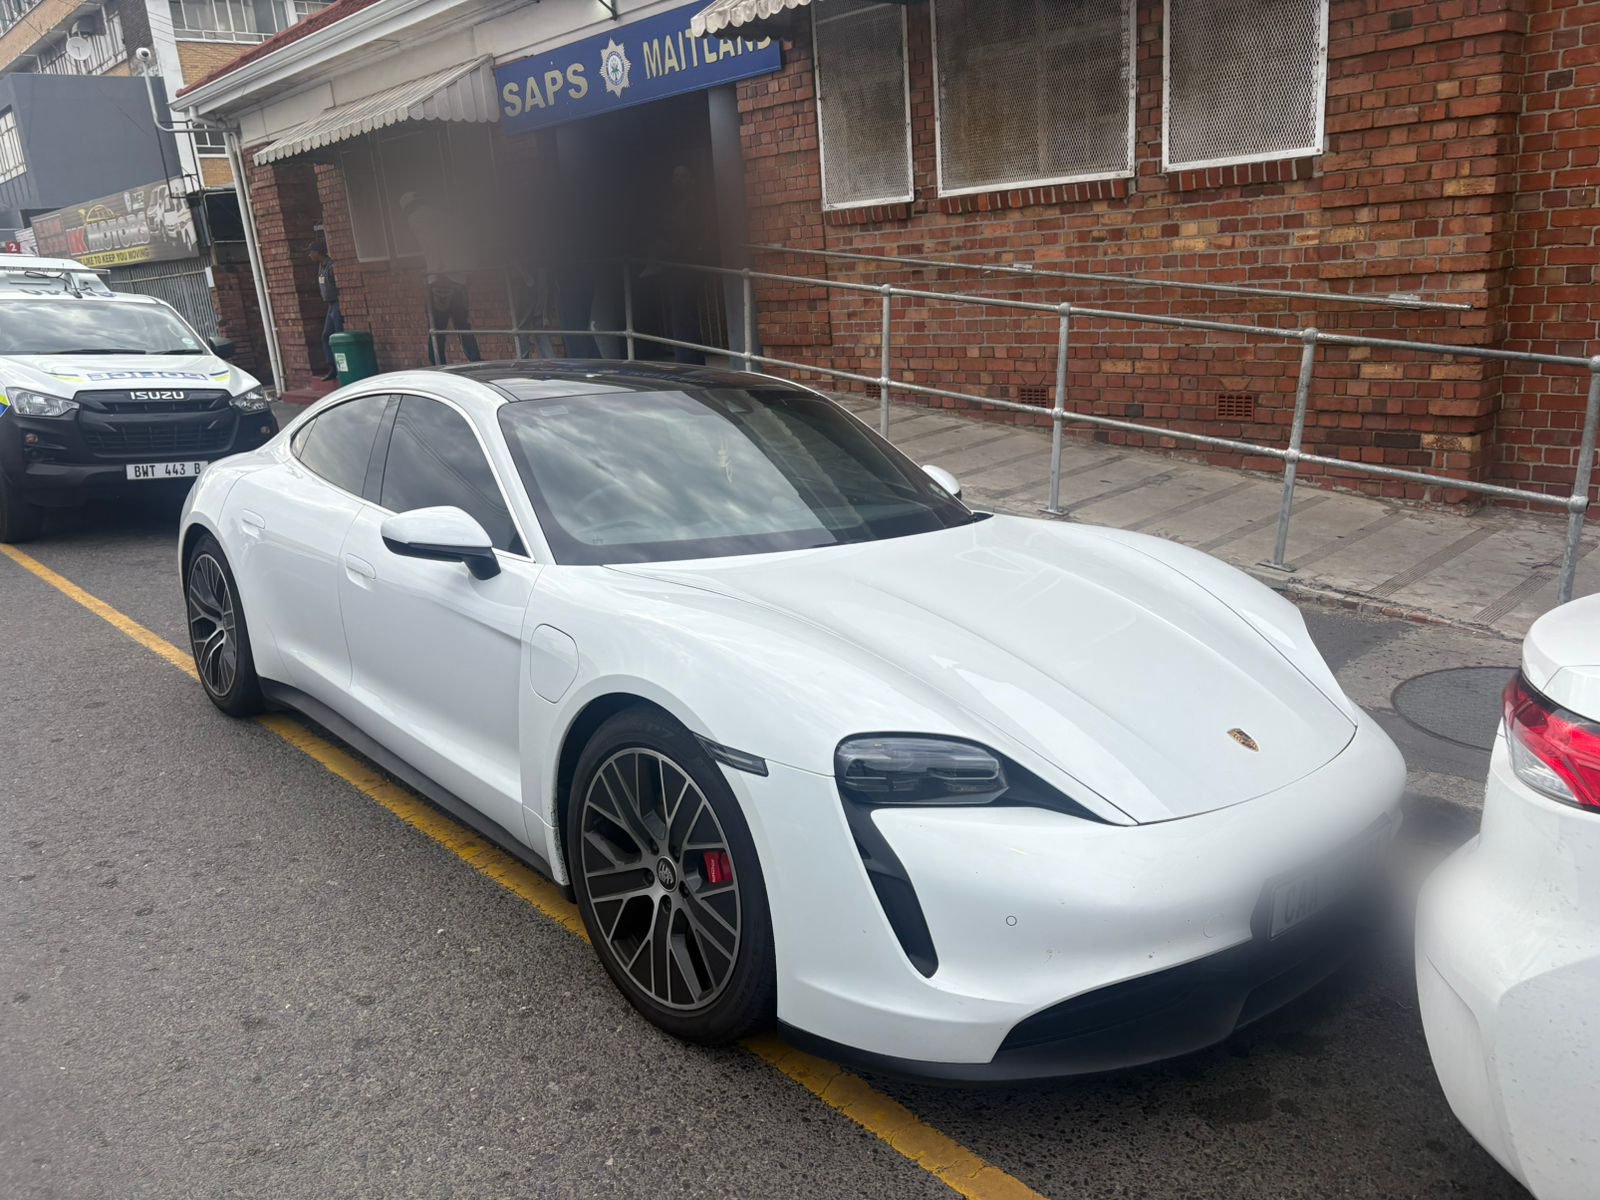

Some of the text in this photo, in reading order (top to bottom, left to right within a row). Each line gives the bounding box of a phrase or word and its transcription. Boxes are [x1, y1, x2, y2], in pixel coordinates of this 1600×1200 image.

[503, 63, 588, 117] SAPS
[87, 212, 150, 251] MOTORS
[9, 242, 18, 252] 2
[83, 256, 95, 265] LIKE
[95, 255, 102, 264] TO
[102, 253, 117, 263] KEEP
[117, 251, 128, 262] YOU
[128, 248, 150, 260] MOVING
[129, 391, 185, 400] ISUZU
[134, 464, 156, 478] BWT
[165, 463, 186, 476] 443
